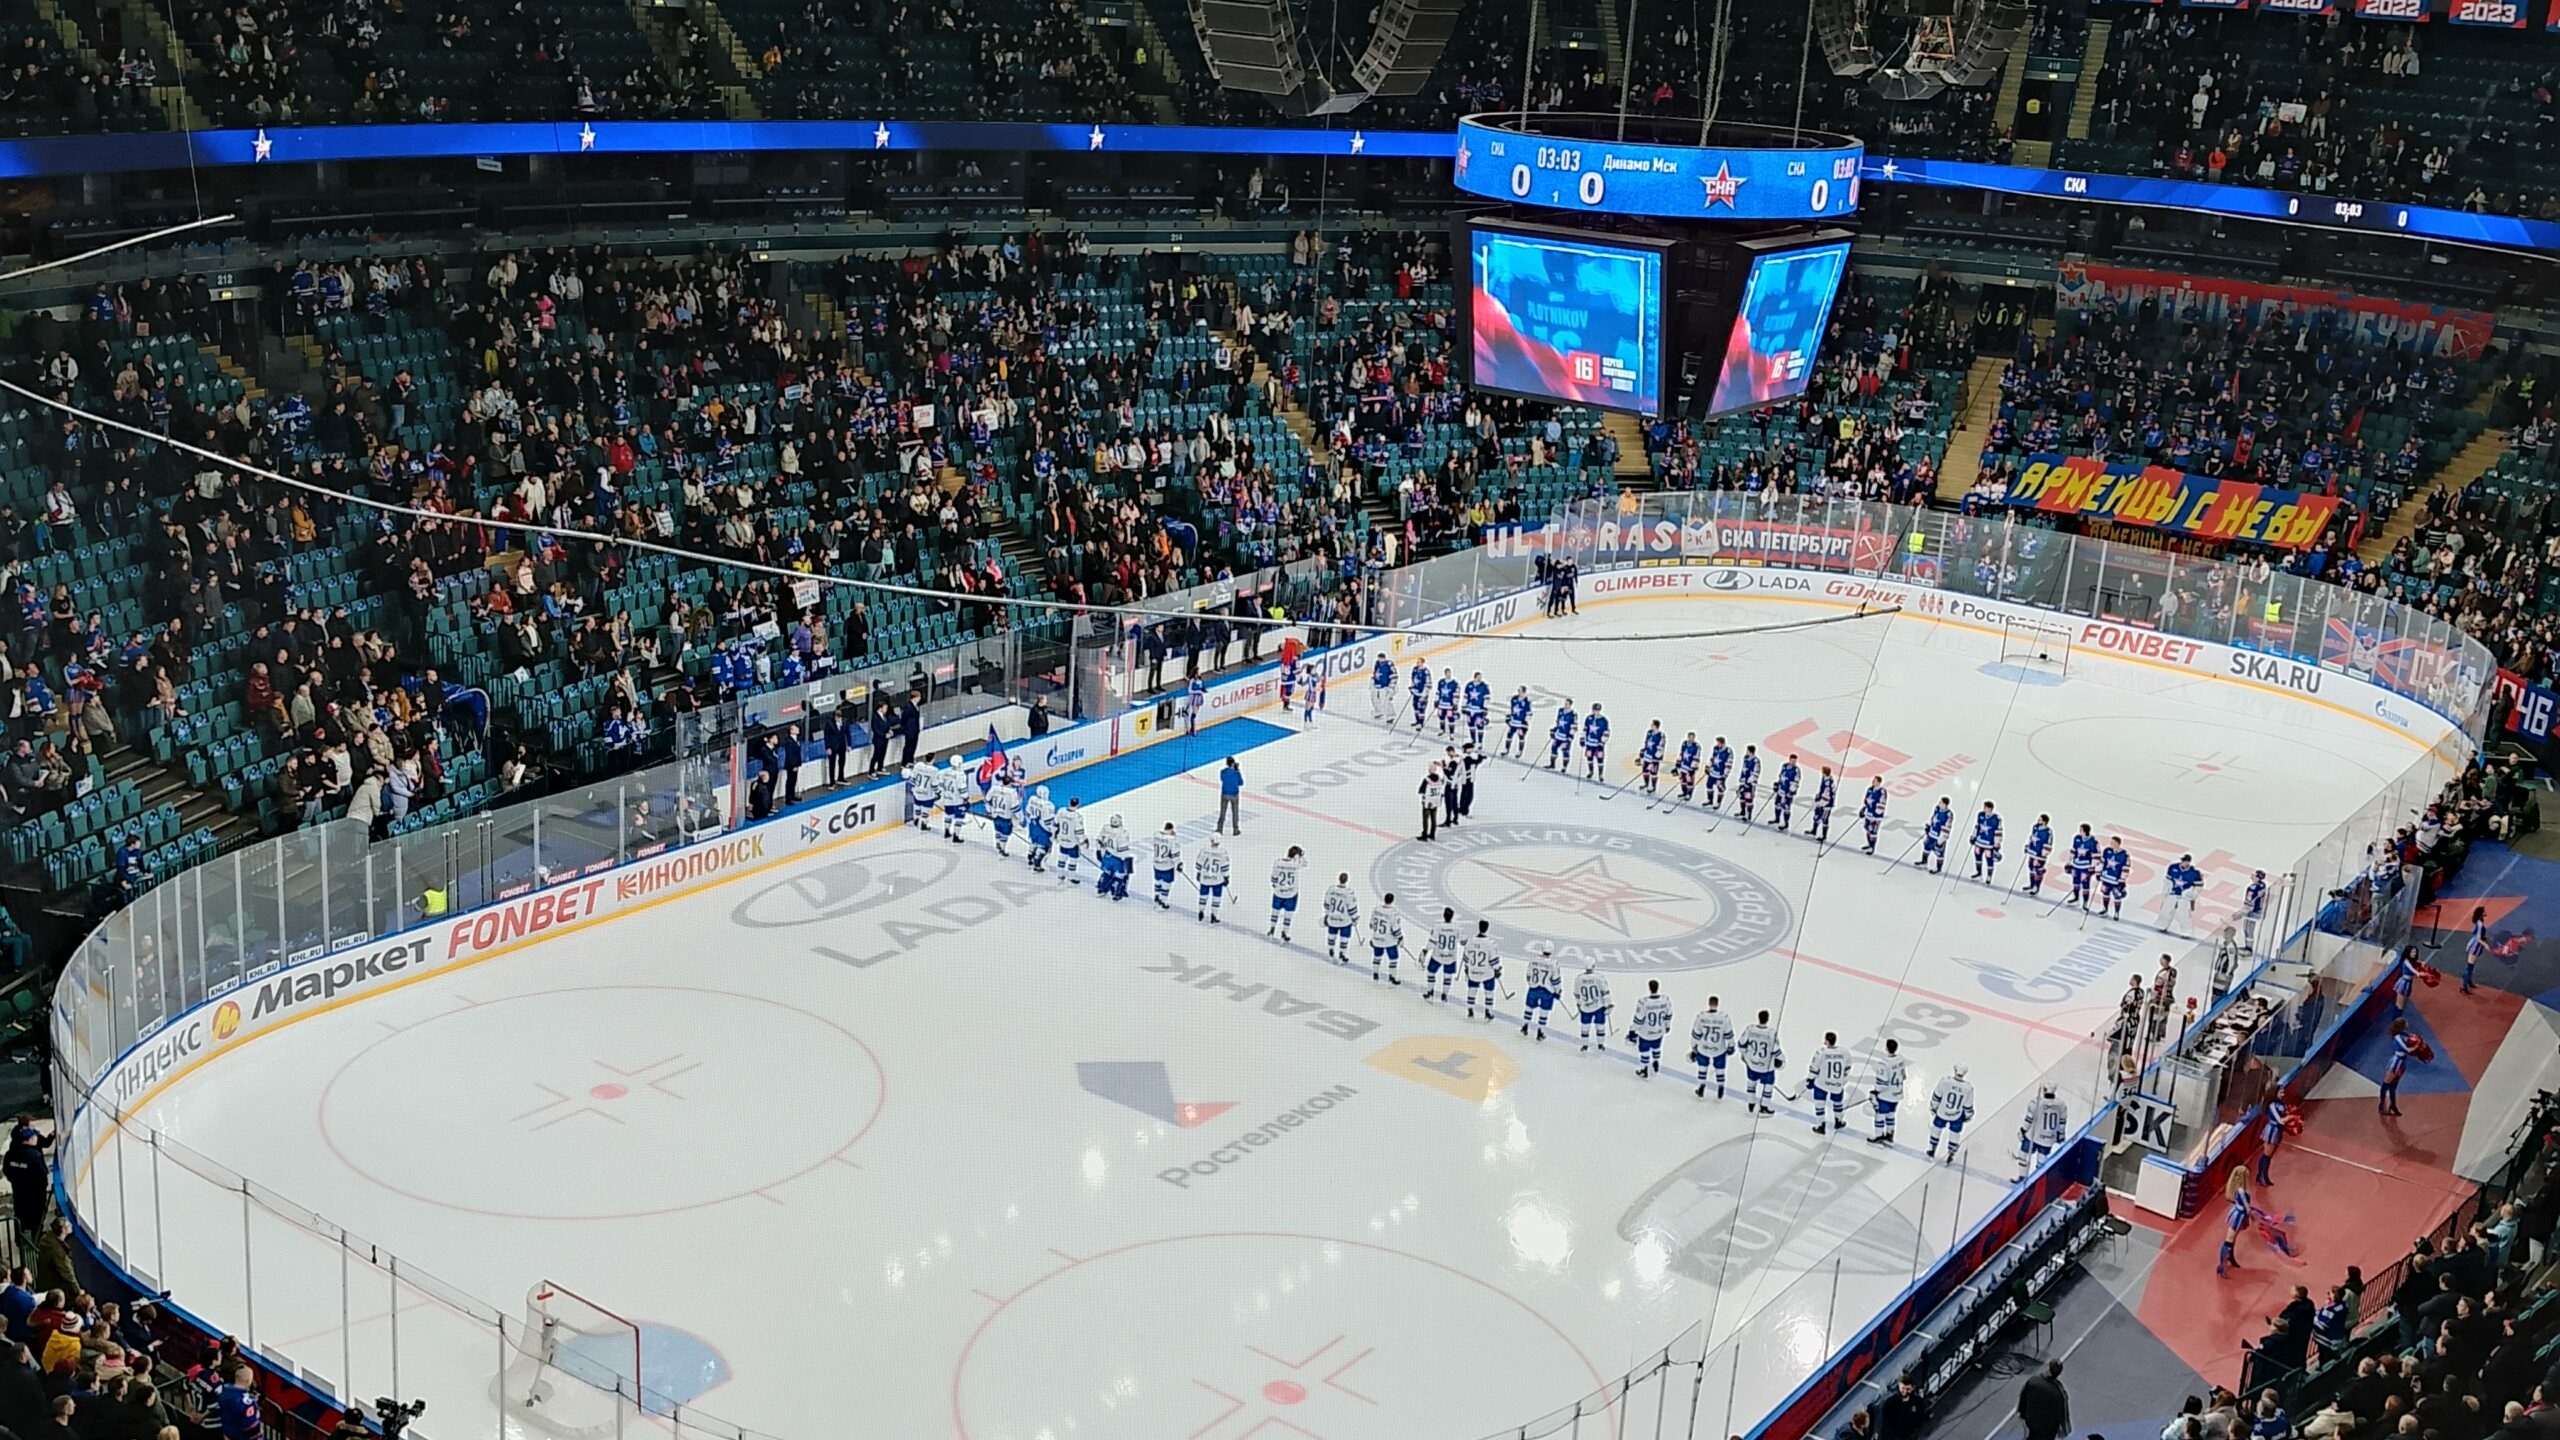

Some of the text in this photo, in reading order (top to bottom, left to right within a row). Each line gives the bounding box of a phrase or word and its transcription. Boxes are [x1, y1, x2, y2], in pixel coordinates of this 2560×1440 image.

[2364, 0, 2420, 17] 2022
[2459, 2, 2516, 23] 2023
[1537, 146, 1581, 171] 03:03
[1602, 154, 1678, 173] Динамо Мск
[1511, 164, 1531, 196] 0
[1579, 171, 1604, 205] 0
[2063, 176, 2087, 194] СКА
[1811, 179, 1829, 212] 0
[2288, 198, 2299, 215] 0
[2334, 202, 2363, 217] 03:03
[2397, 210, 2408, 228] 0
[217, 274, 233, 286] 212
[1575, 356, 1594, 381] 16
[2010, 462, 2330, 543] АРМЕЙЦЫ С НЕВЫ
[1721, 528, 1853, 558] СКА ПЕТЕРБУРГ
[1594, 573, 1693, 593] OLIMPBET
[1759, 576, 1811, 591] LADA
[1455, 599, 1518, 633] KHL.RU
[2080, 623, 2204, 664] FONBET
[2229, 651, 2323, 694] SKA.RU
[1211, 677, 1281, 710] OLIMPBET
[828, 802, 876, 834] сбп
[1507, 829, 1633, 850] КЛУБ
[636, 843, 666, 859] FONBET
[616, 834, 765, 902] КИНОПОИСК
[1203, 858, 1219, 874] 45
[1278, 871, 1295, 886] 25
[447, 880, 604, 959] FONBET
[810, 880, 1064, 969] LADA
[334, 933, 366, 950] KHL.RU
[1438, 933, 1456, 951] 98
[291, 946, 322, 964] KHL.RU
[1469, 950, 1487, 967] 32
[248, 962, 278, 980] KHL.RU
[1531, 968, 1549, 984] 87
[210, 978, 238, 997] KHL.RU
[1580, 985, 1599, 1002] 90
[114, 1022, 201, 1102] Яндекс
[250, 937, 432, 1021] Маркет
[1647, 1011, 1665, 1028] 96
[1702, 1025, 1721, 1043] 75
[1751, 1040, 1768, 1059] 93
[1827, 1060, 1842, 1079] 19
[1945, 1091, 1964, 1110] 91
[2042, 1111, 2058, 1130] 10
[1156, 1084, 1360, 1190] Ростелеком
